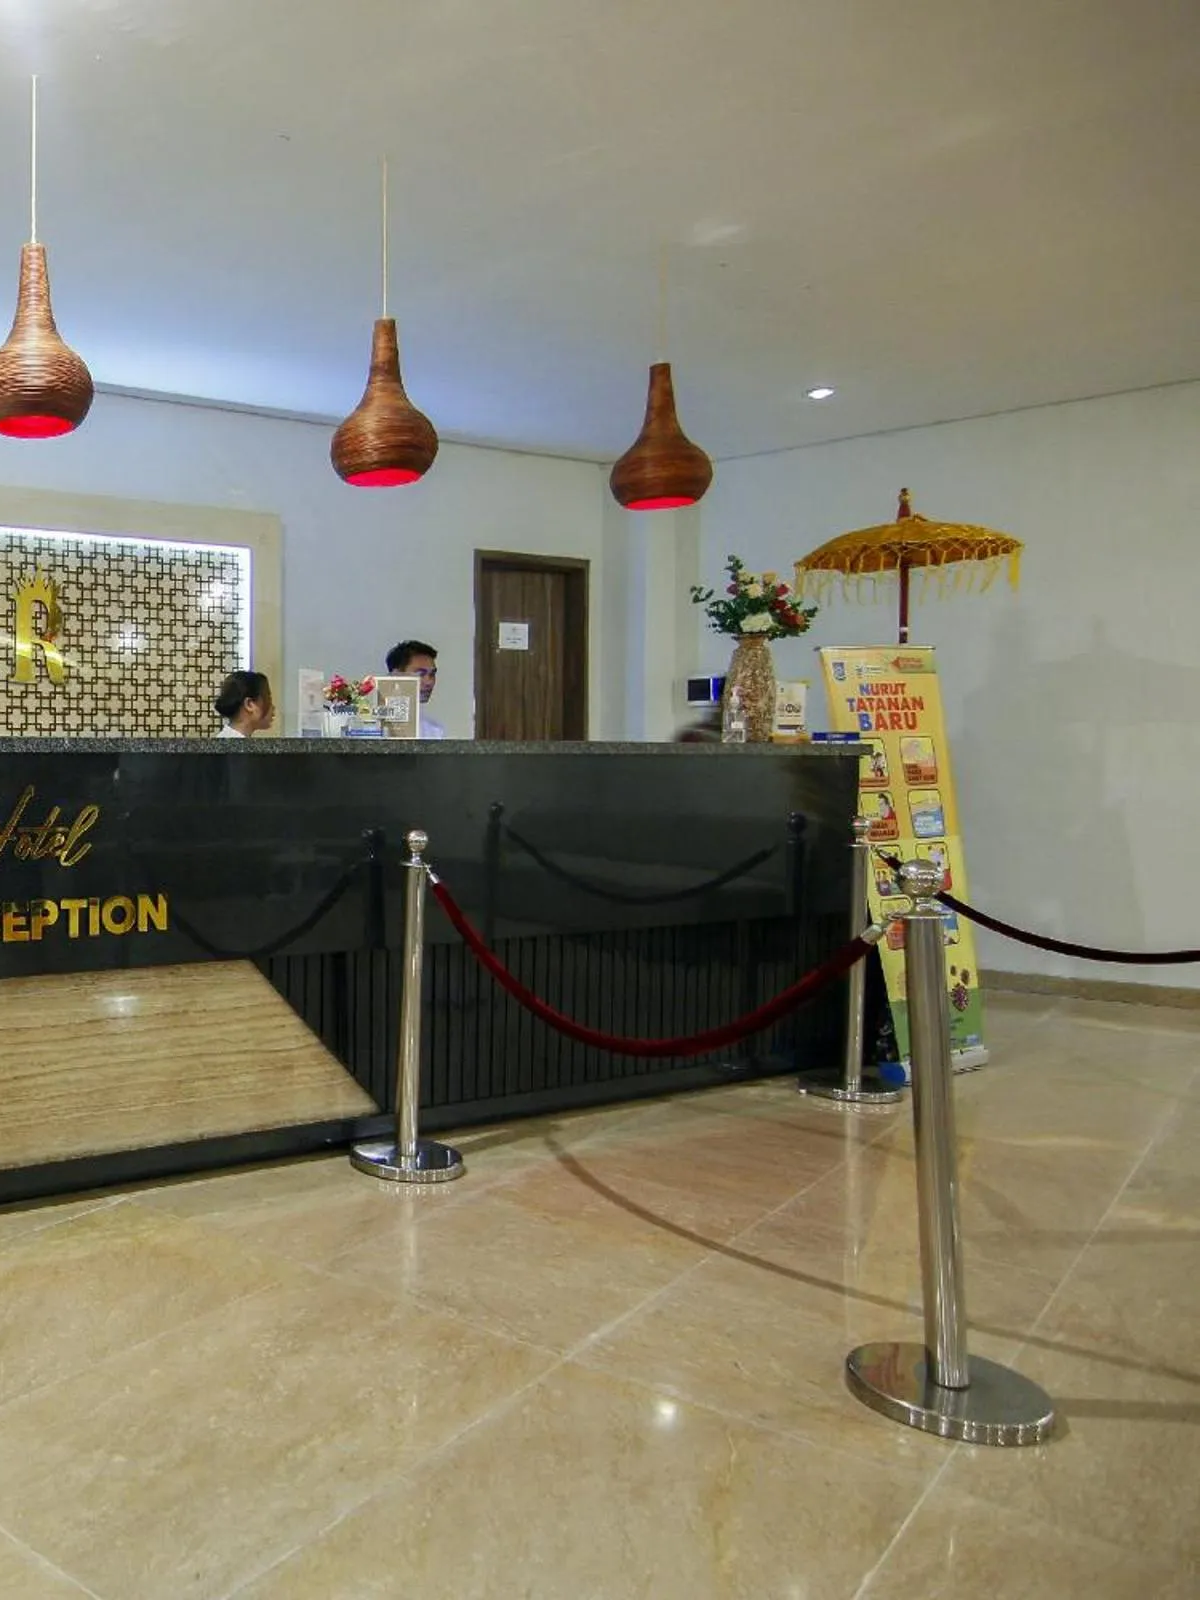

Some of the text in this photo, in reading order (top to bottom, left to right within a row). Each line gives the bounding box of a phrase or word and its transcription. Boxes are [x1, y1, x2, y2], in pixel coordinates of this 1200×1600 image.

[13, 563, 65, 684] R
[859, 683, 906, 696] NURUT
[847, 696, 924, 713] TATANAN
[858, 711, 918, 731] BARU
